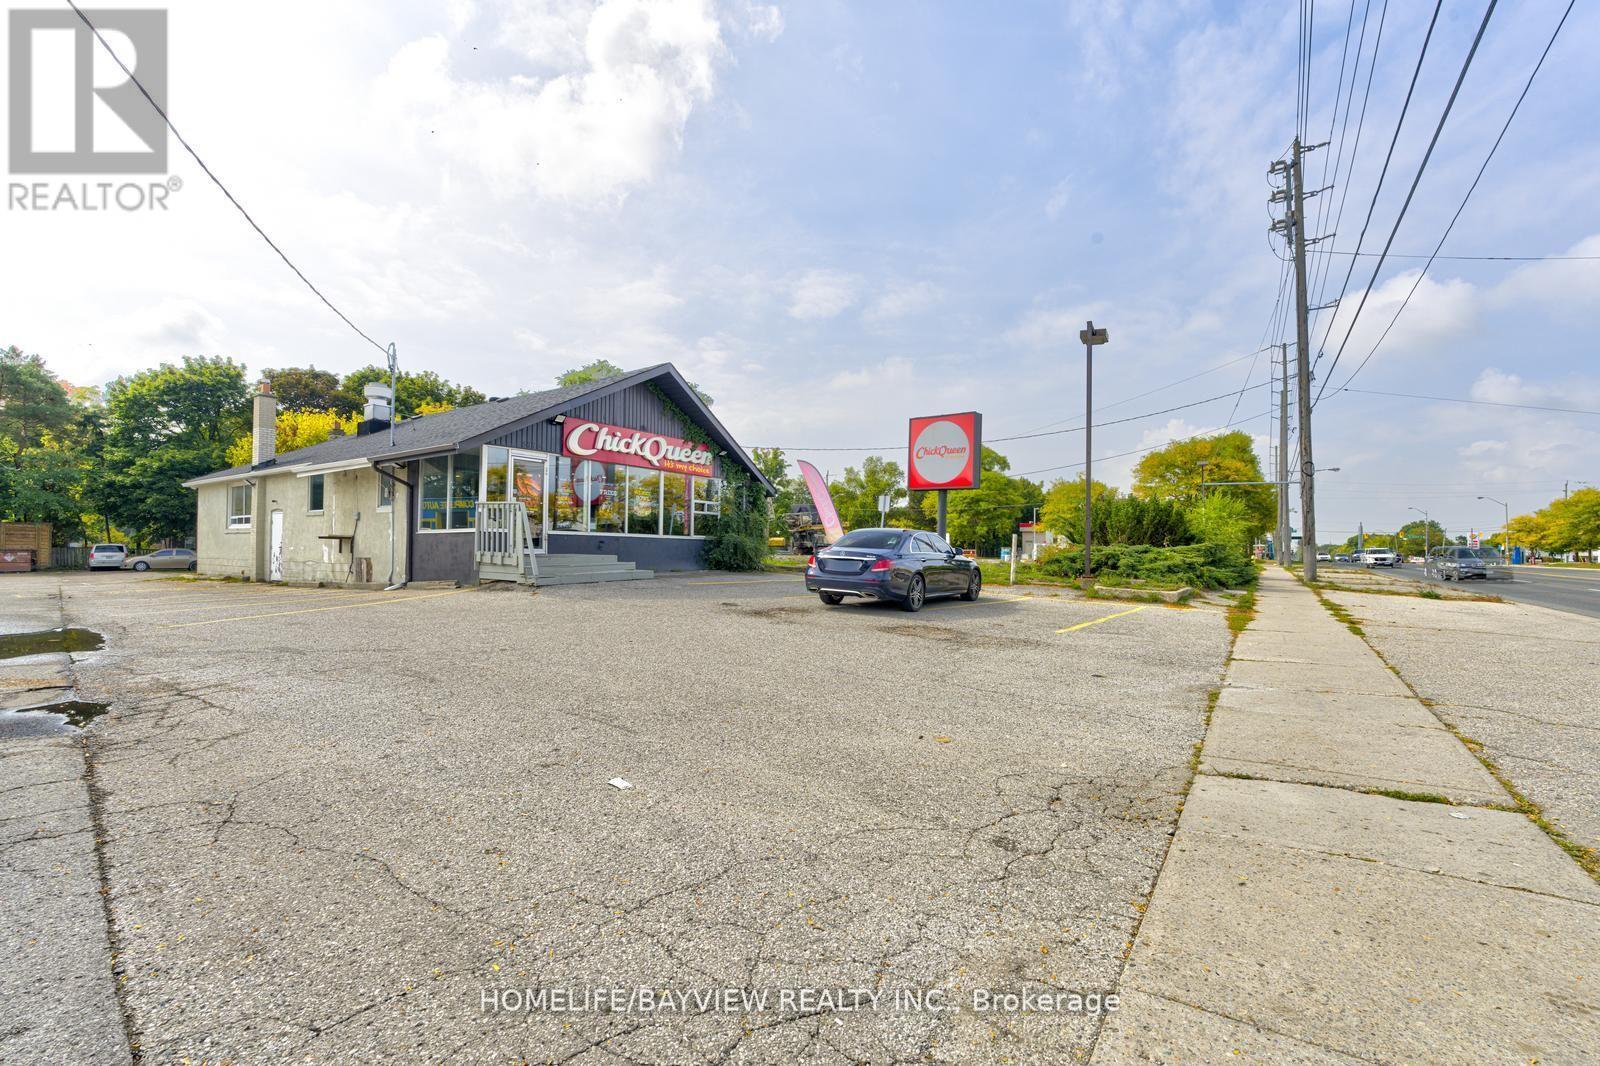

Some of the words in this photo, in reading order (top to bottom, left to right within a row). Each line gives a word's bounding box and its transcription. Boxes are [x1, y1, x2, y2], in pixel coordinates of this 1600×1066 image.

[566, 423, 713, 467] ChickQueen
[916, 444, 967, 460] ChickQueen
[676, 463, 688, 472] my
